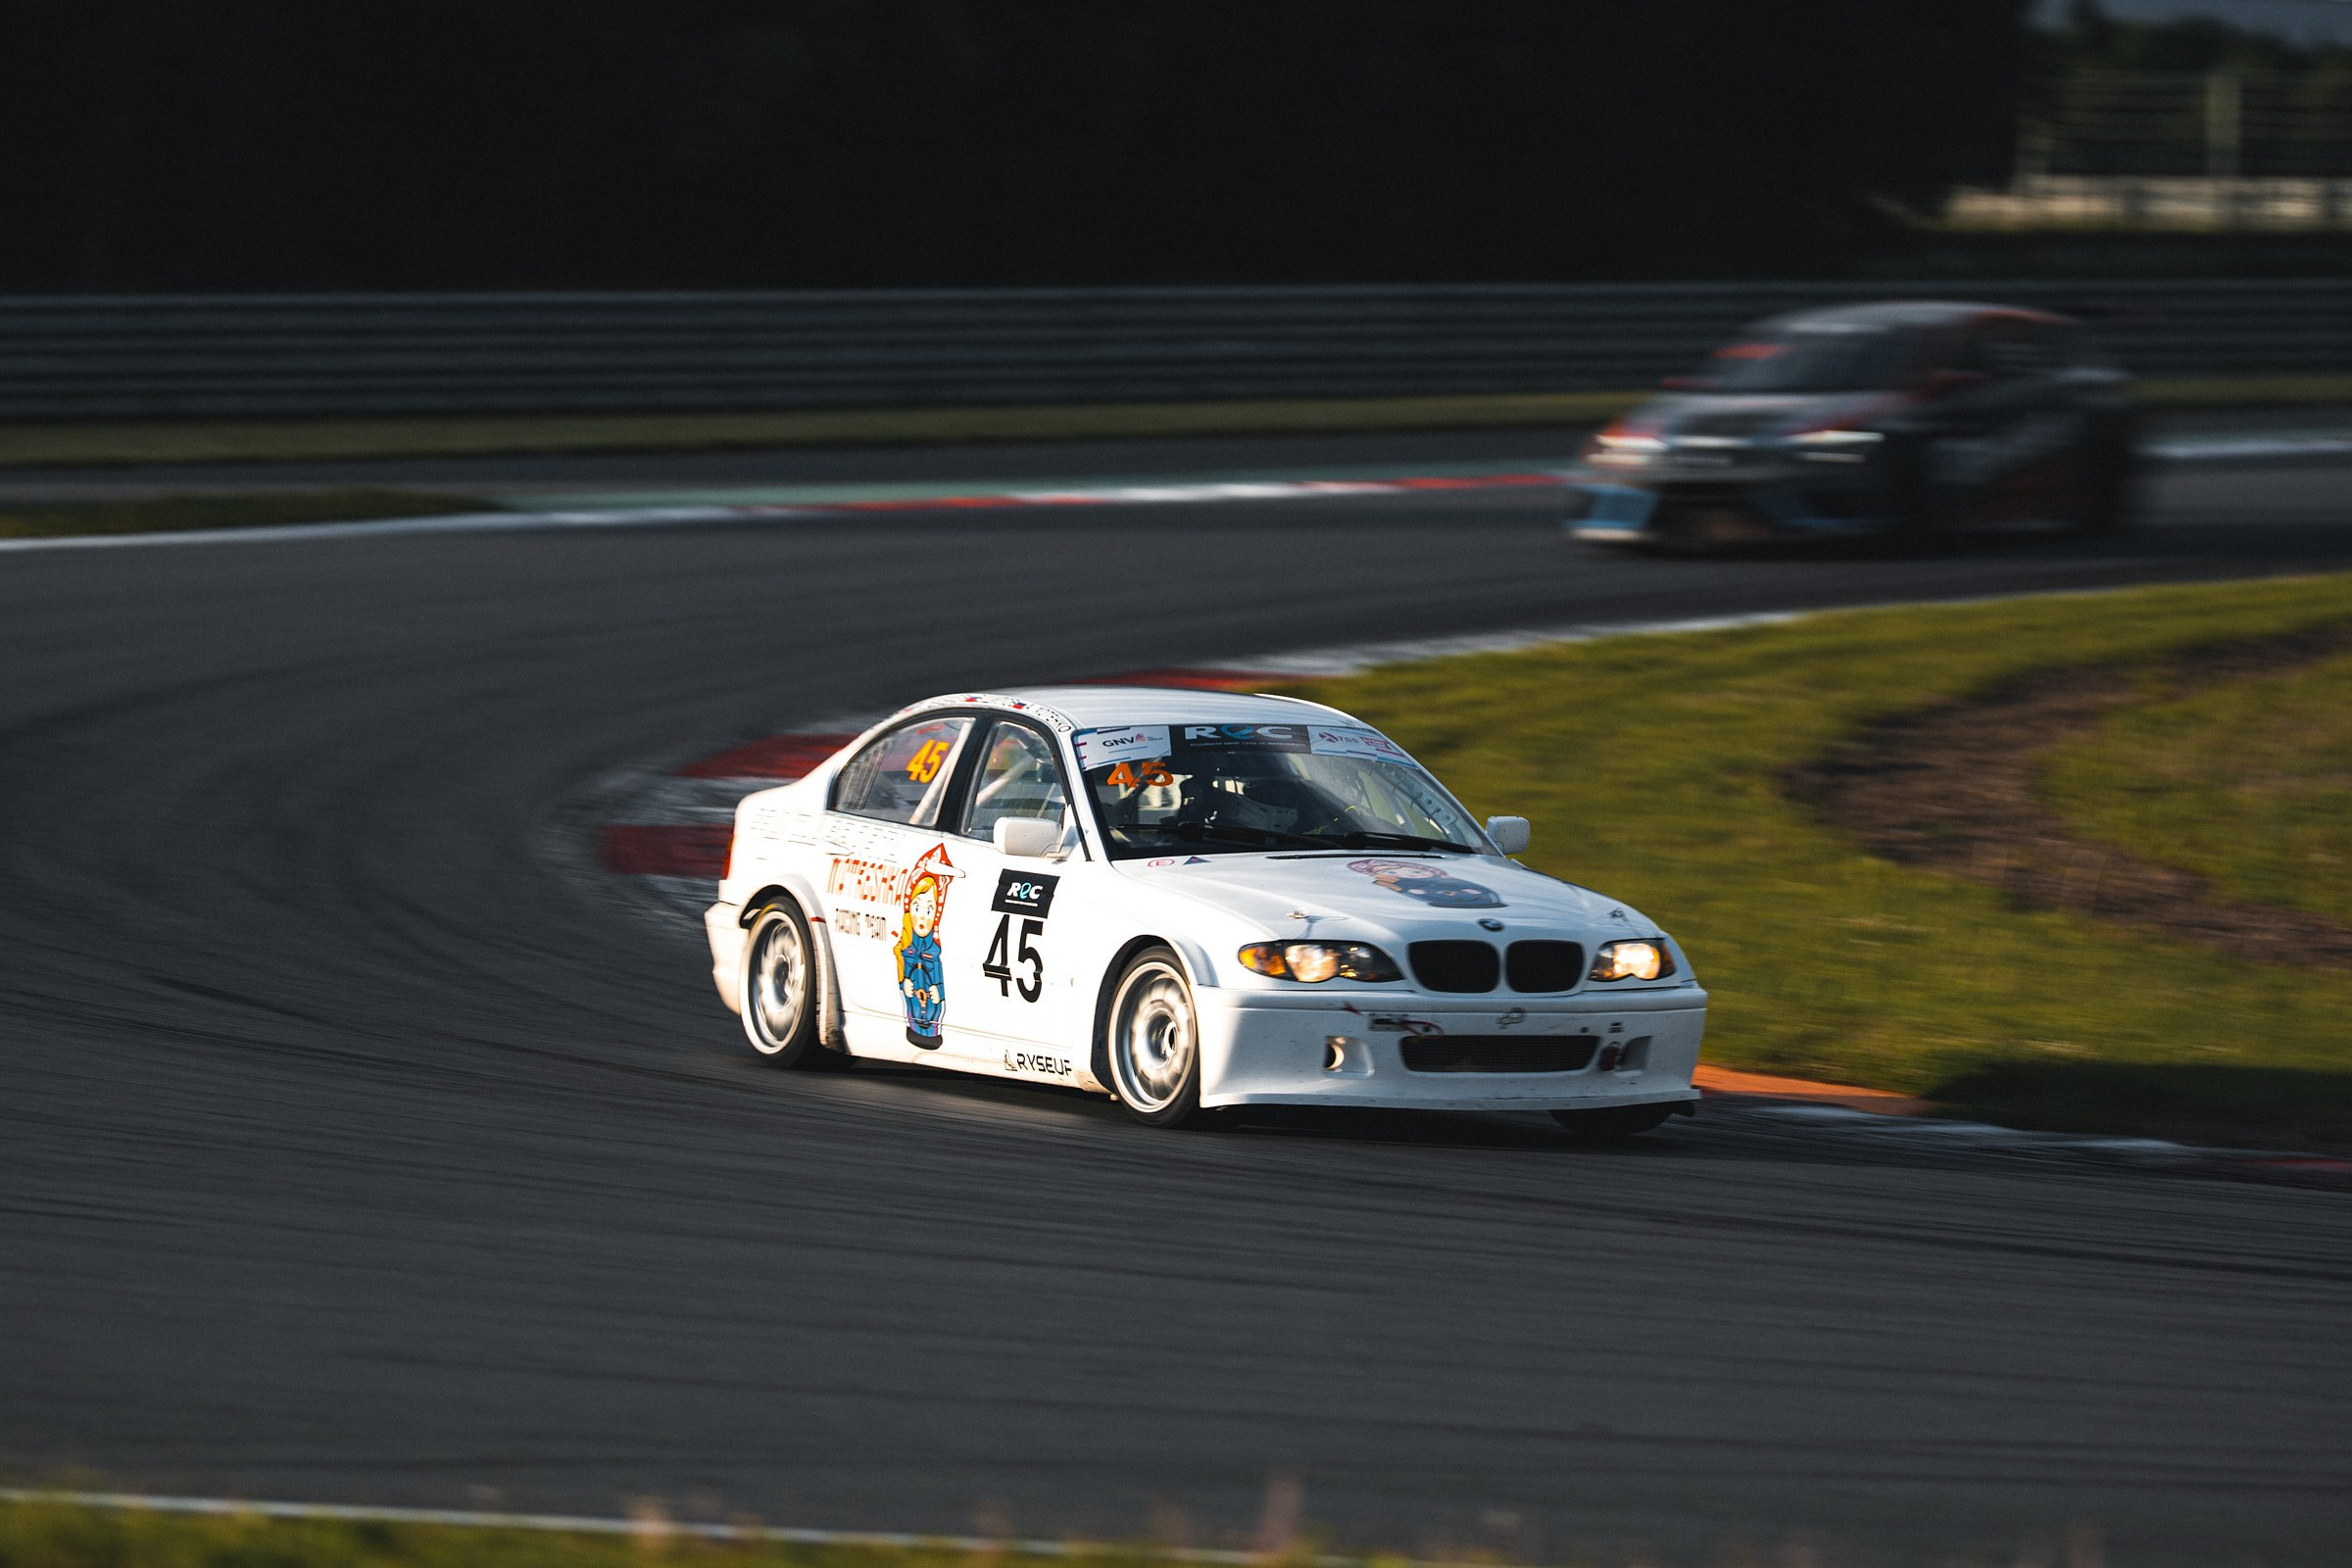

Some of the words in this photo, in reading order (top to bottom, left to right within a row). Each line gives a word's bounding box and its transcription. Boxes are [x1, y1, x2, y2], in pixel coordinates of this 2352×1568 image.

[1102, 736, 1135, 747] GNV
[906, 739, 951, 784] 45
[1106, 761, 1174, 788] 45
[982, 913, 1044, 1004] 45
